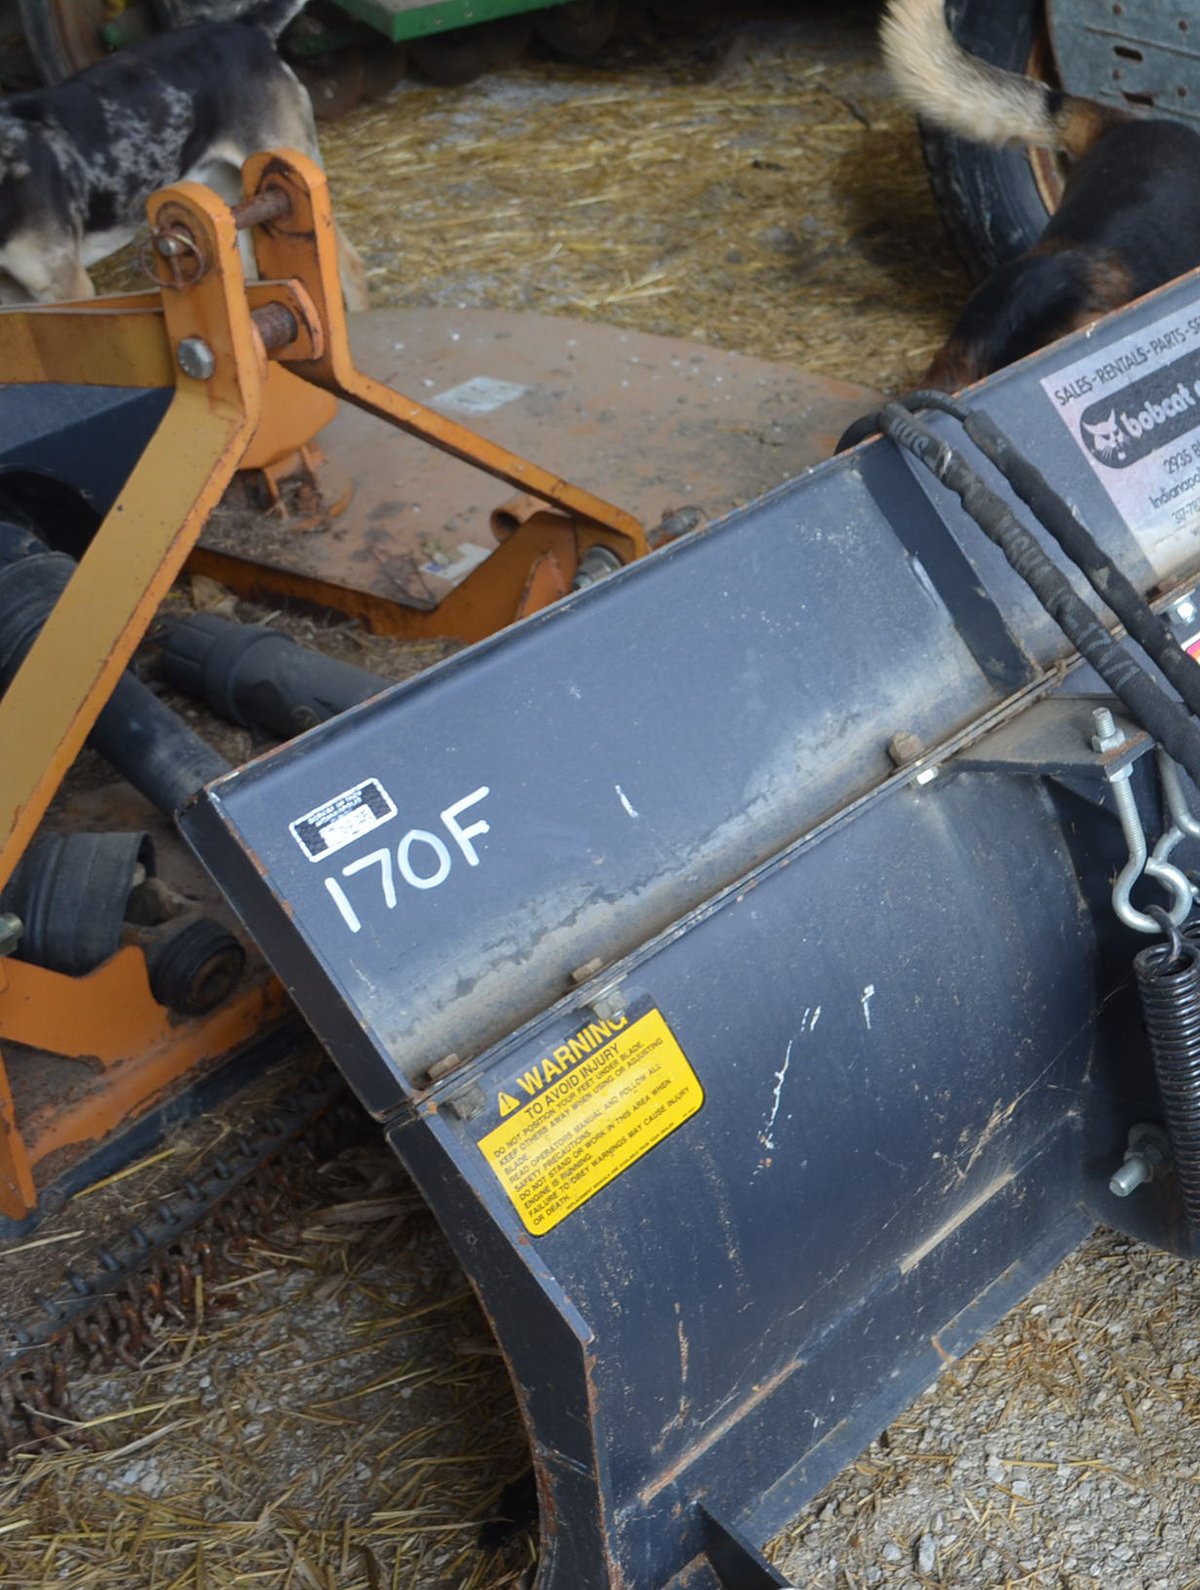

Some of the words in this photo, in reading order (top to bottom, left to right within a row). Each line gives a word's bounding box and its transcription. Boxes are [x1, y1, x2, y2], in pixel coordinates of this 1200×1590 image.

[1120, 382, 1197, 438] bobcat
[1161, 448, 1193, 474] 2935
[324, 786, 491, 934] 170F
[493, 1144, 506, 1158] DO
[505, 1133, 522, 1148] NOT
[522, 1106, 556, 1136] POSITION
[555, 1090, 577, 1110] YOUR
[576, 1077, 595, 1094] FEET
[594, 1058, 620, 1080] UNDER
[498, 1147, 520, 1167] KEEP
[519, 1124, 549, 1150] OTHERS
[549, 1108, 571, 1128] AWAY
[571, 1091, 593, 1111] WHEN
[592, 1074, 615, 1094] USING
[613, 1065, 626, 1077] OR
[625, 1037, 663, 1068] ADJUSTING
[508, 1164, 530, 1184] READ
[529, 1130, 573, 1167] OPERATORS
[572, 1108, 602, 1134] MANUAL
[603, 1095, 619, 1110] AND
[618, 1073, 647, 1098] FOLLOW
[647, 1062, 662, 1075] ALL
[524, 1100, 544, 1121] TO
[542, 1072, 581, 1107] AVOID
[578, 1041, 621, 1079] INJURY
[513, 1167, 541, 1192] SAFETY
[518, 1187, 531, 1201] DO
[530, 1175, 547, 1191] NOT
[547, 1155, 572, 1178] STAND
[571, 1146, 584, 1159] OR
[584, 1128, 607, 1149] WORK
[606, 1122, 615, 1132] IN
[615, 1109, 632, 1124] THIS
[632, 1094, 651, 1111] AREA
[650, 1077, 672, 1097] WHEN
[527, 1190, 558, 1217] FAILURE
[558, 1181, 570, 1193] TO
[569, 1165, 590, 1184] OBEY
[590, 1135, 627, 1167] WARNINGS
[626, 1123, 643, 1139] MAY
[642, 1104, 667, 1126] CAUSE
[666, 1085, 691, 1107] INJURY
[523, 1184, 551, 1209] ENGINE
[550, 1177, 560, 1188] IS
[532, 1213, 545, 1226] OR
